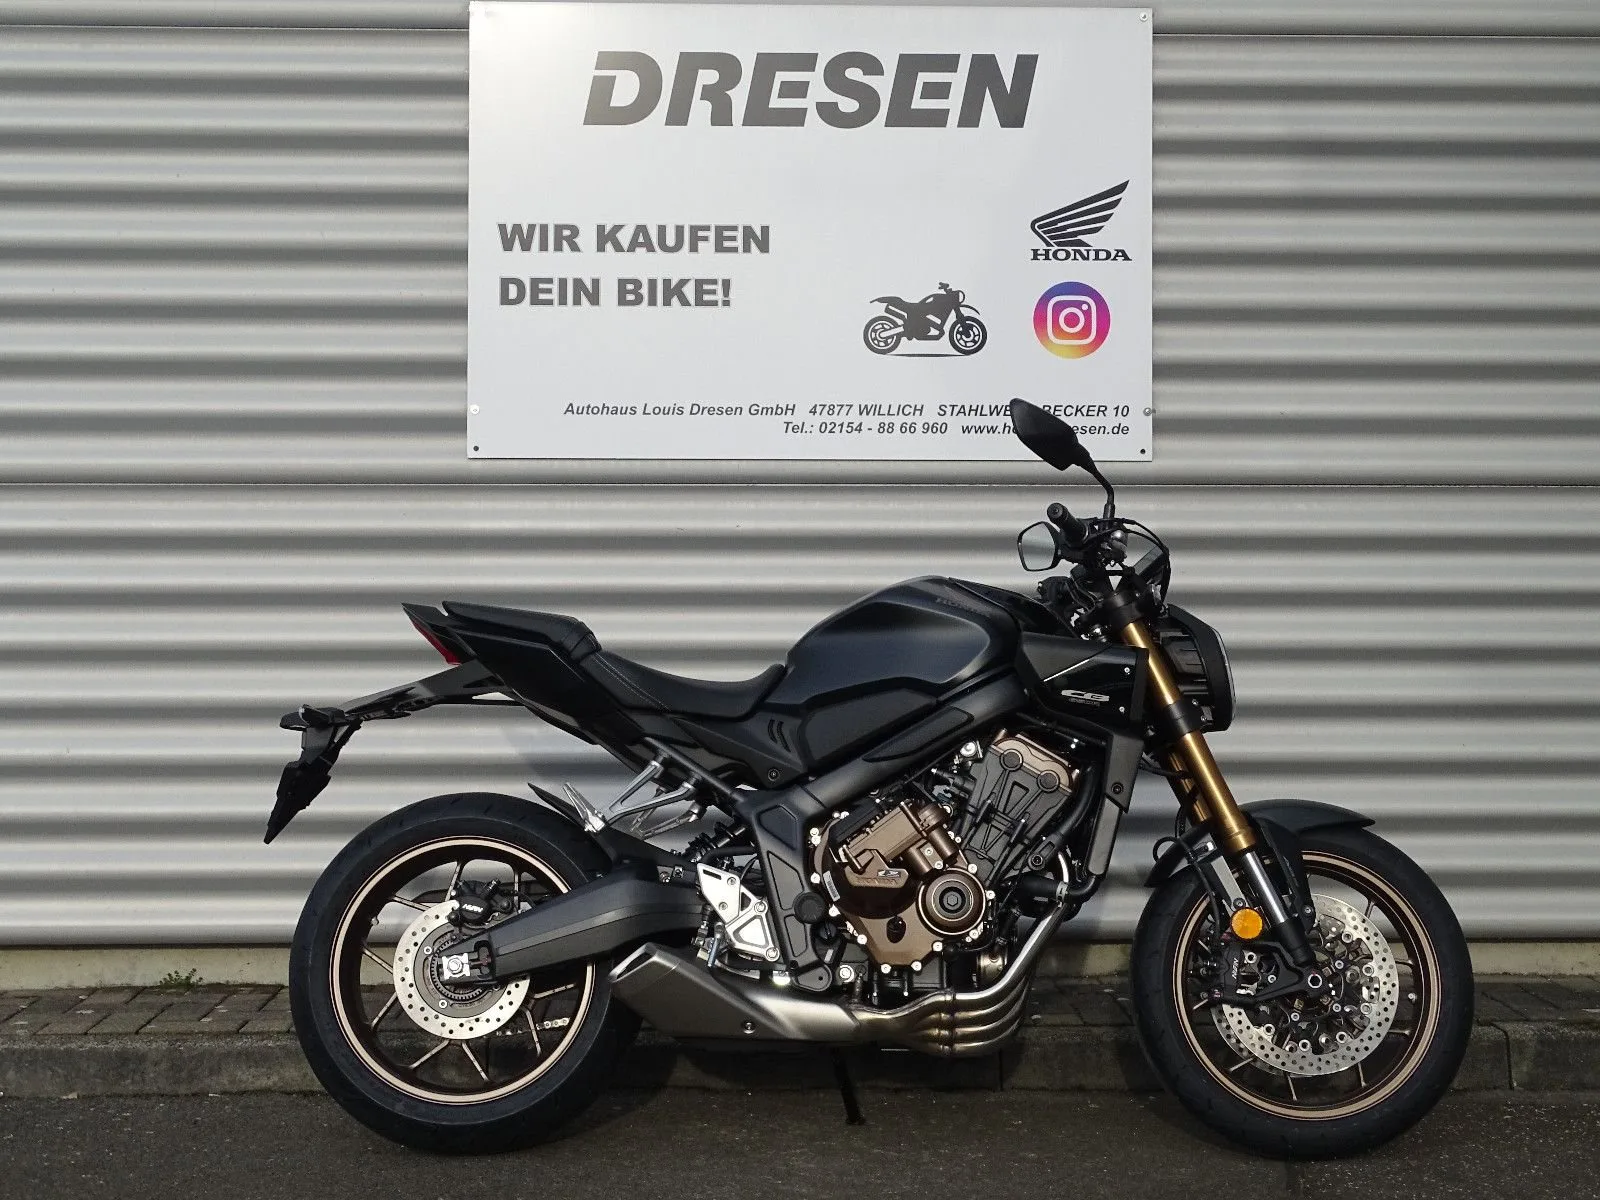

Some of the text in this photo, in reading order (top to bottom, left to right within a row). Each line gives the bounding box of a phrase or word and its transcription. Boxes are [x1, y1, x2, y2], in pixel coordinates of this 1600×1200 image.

[582, 51, 1040, 130] DRESEN
[497, 223, 770, 254] WIR KAUFEN
[1030, 248, 1133, 262] HONDA
[499, 277, 732, 307] DEIN BIKE!
[563, 402, 638, 416] Autohaus
[642, 402, 685, 416] Louis
[689, 403, 743, 416] Dresen
[748, 403, 796, 416] GmbH
[808, 403, 854, 416] 47877
[858, 403, 925, 417] WILLICH
[937, 403, 1012, 418] STAHLWE
[1113, 404, 1130, 418] 10
[783, 421, 814, 434] Tel.:
[818, 421, 863, 434] 02154
[877, 421, 895, 434] 88
[899, 421, 917, 434] 66
[921, 421, 948, 435] 960
[961, 422, 1130, 436] www.hesen.de
[1061, 689, 1110, 702] CB
